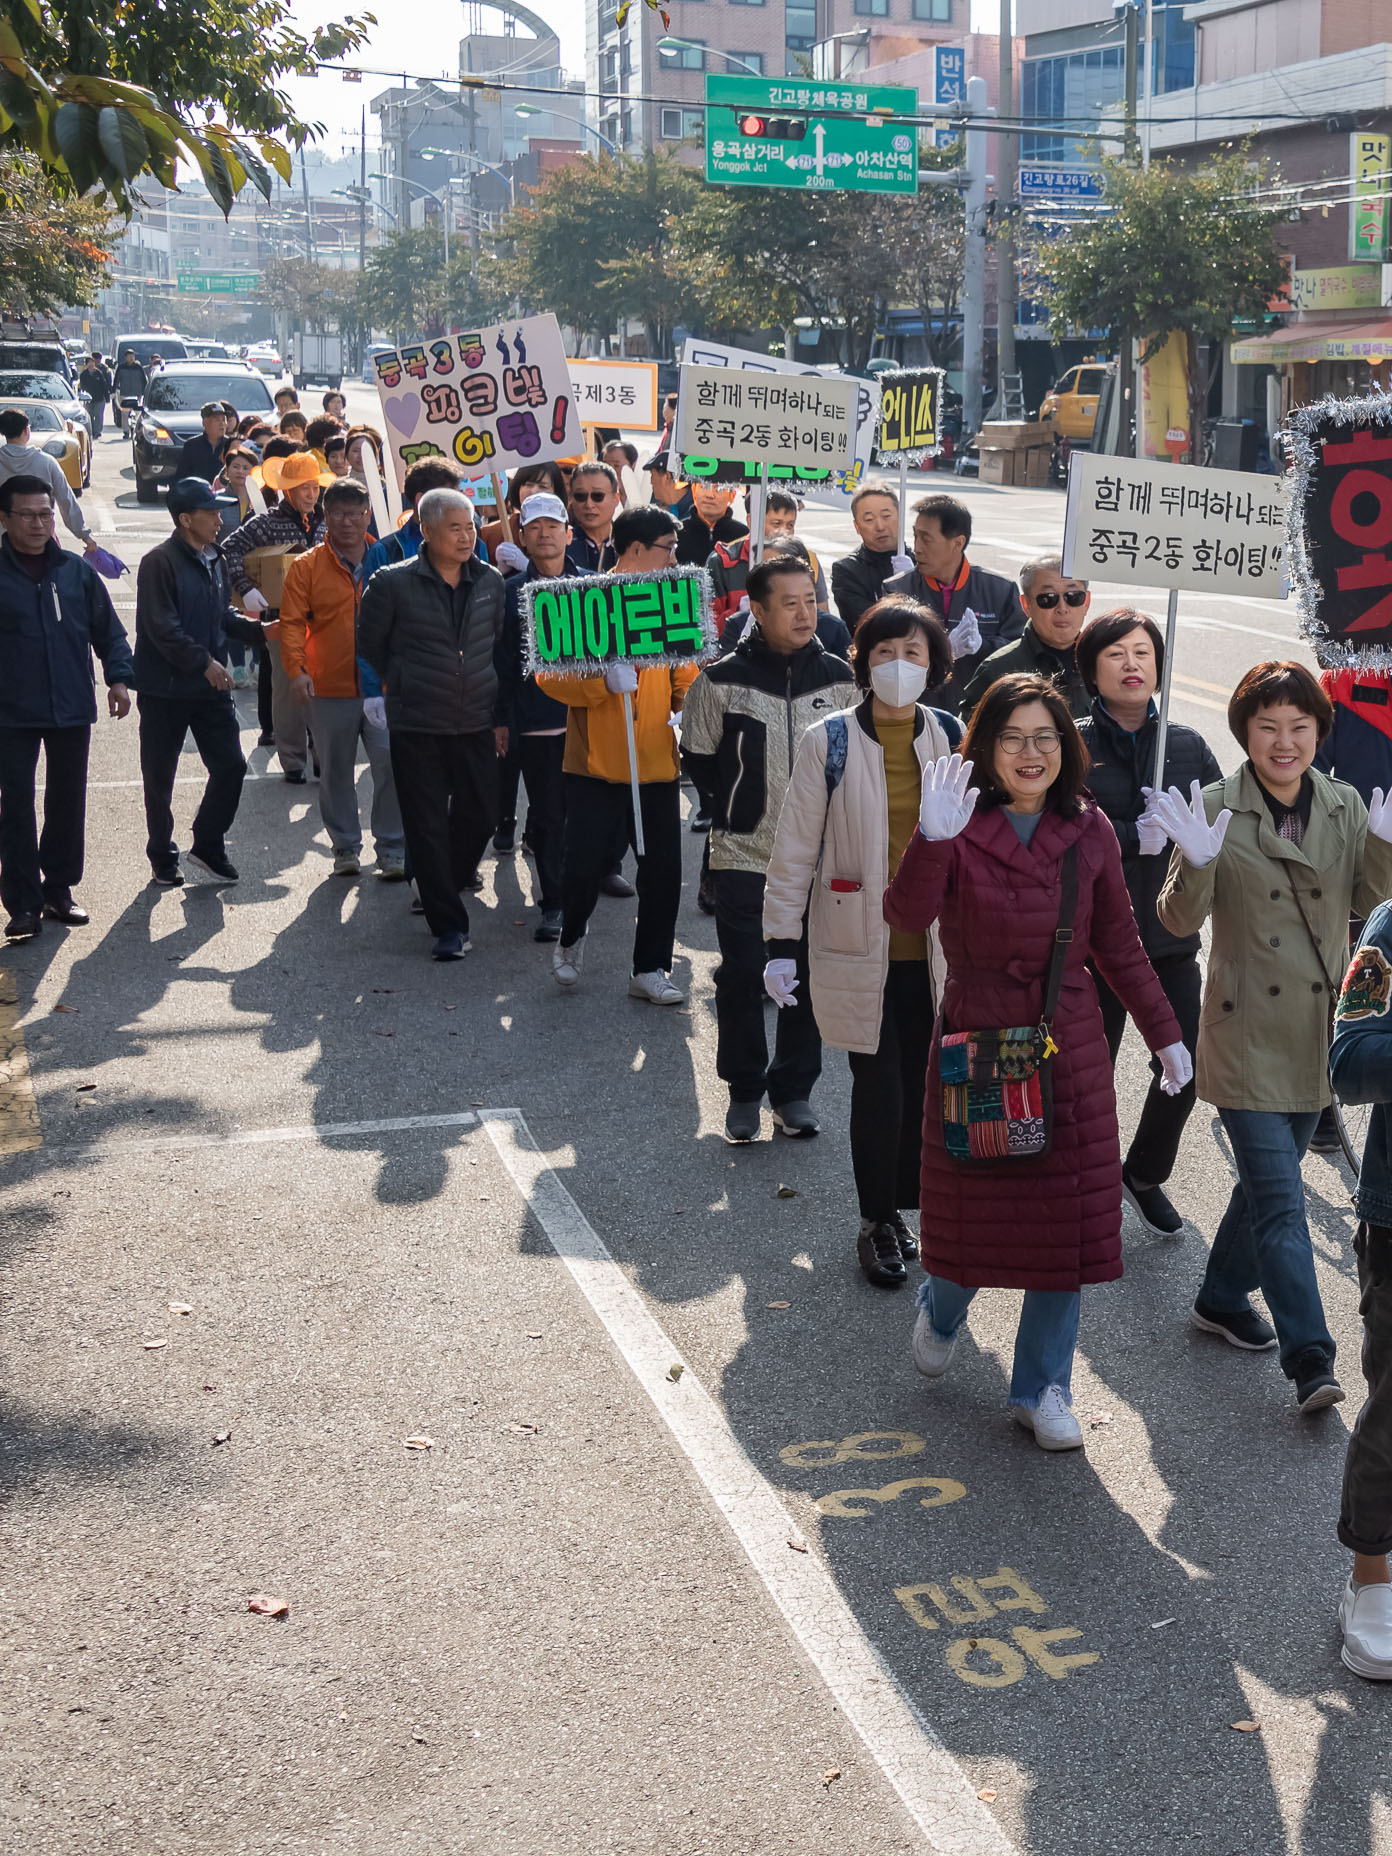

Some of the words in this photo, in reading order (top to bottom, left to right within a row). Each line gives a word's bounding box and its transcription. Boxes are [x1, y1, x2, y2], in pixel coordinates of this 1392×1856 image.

[768, 86, 868, 110] 긴고랑체육공원
[711, 139, 784, 161] 용곡삼거리
[855, 149, 914, 170] 아차산역
[711, 158, 751, 173] Yonggok
[753, 161, 768, 173] Jct
[805, 174, 835, 187] 200m
[856, 167, 895, 181] Achasan
[897, 169, 913, 182] Stn
[420, 364, 548, 425] 핑크빛
[696, 380, 742, 410] 함께
[881, 383, 936, 451] 언니쓰
[694, 417, 772, 449] 중곡2동
[1095, 475, 1153, 516] 함께
[1089, 528, 1185, 570] 중곡2동
[534, 578, 704, 662] 에어로빅
